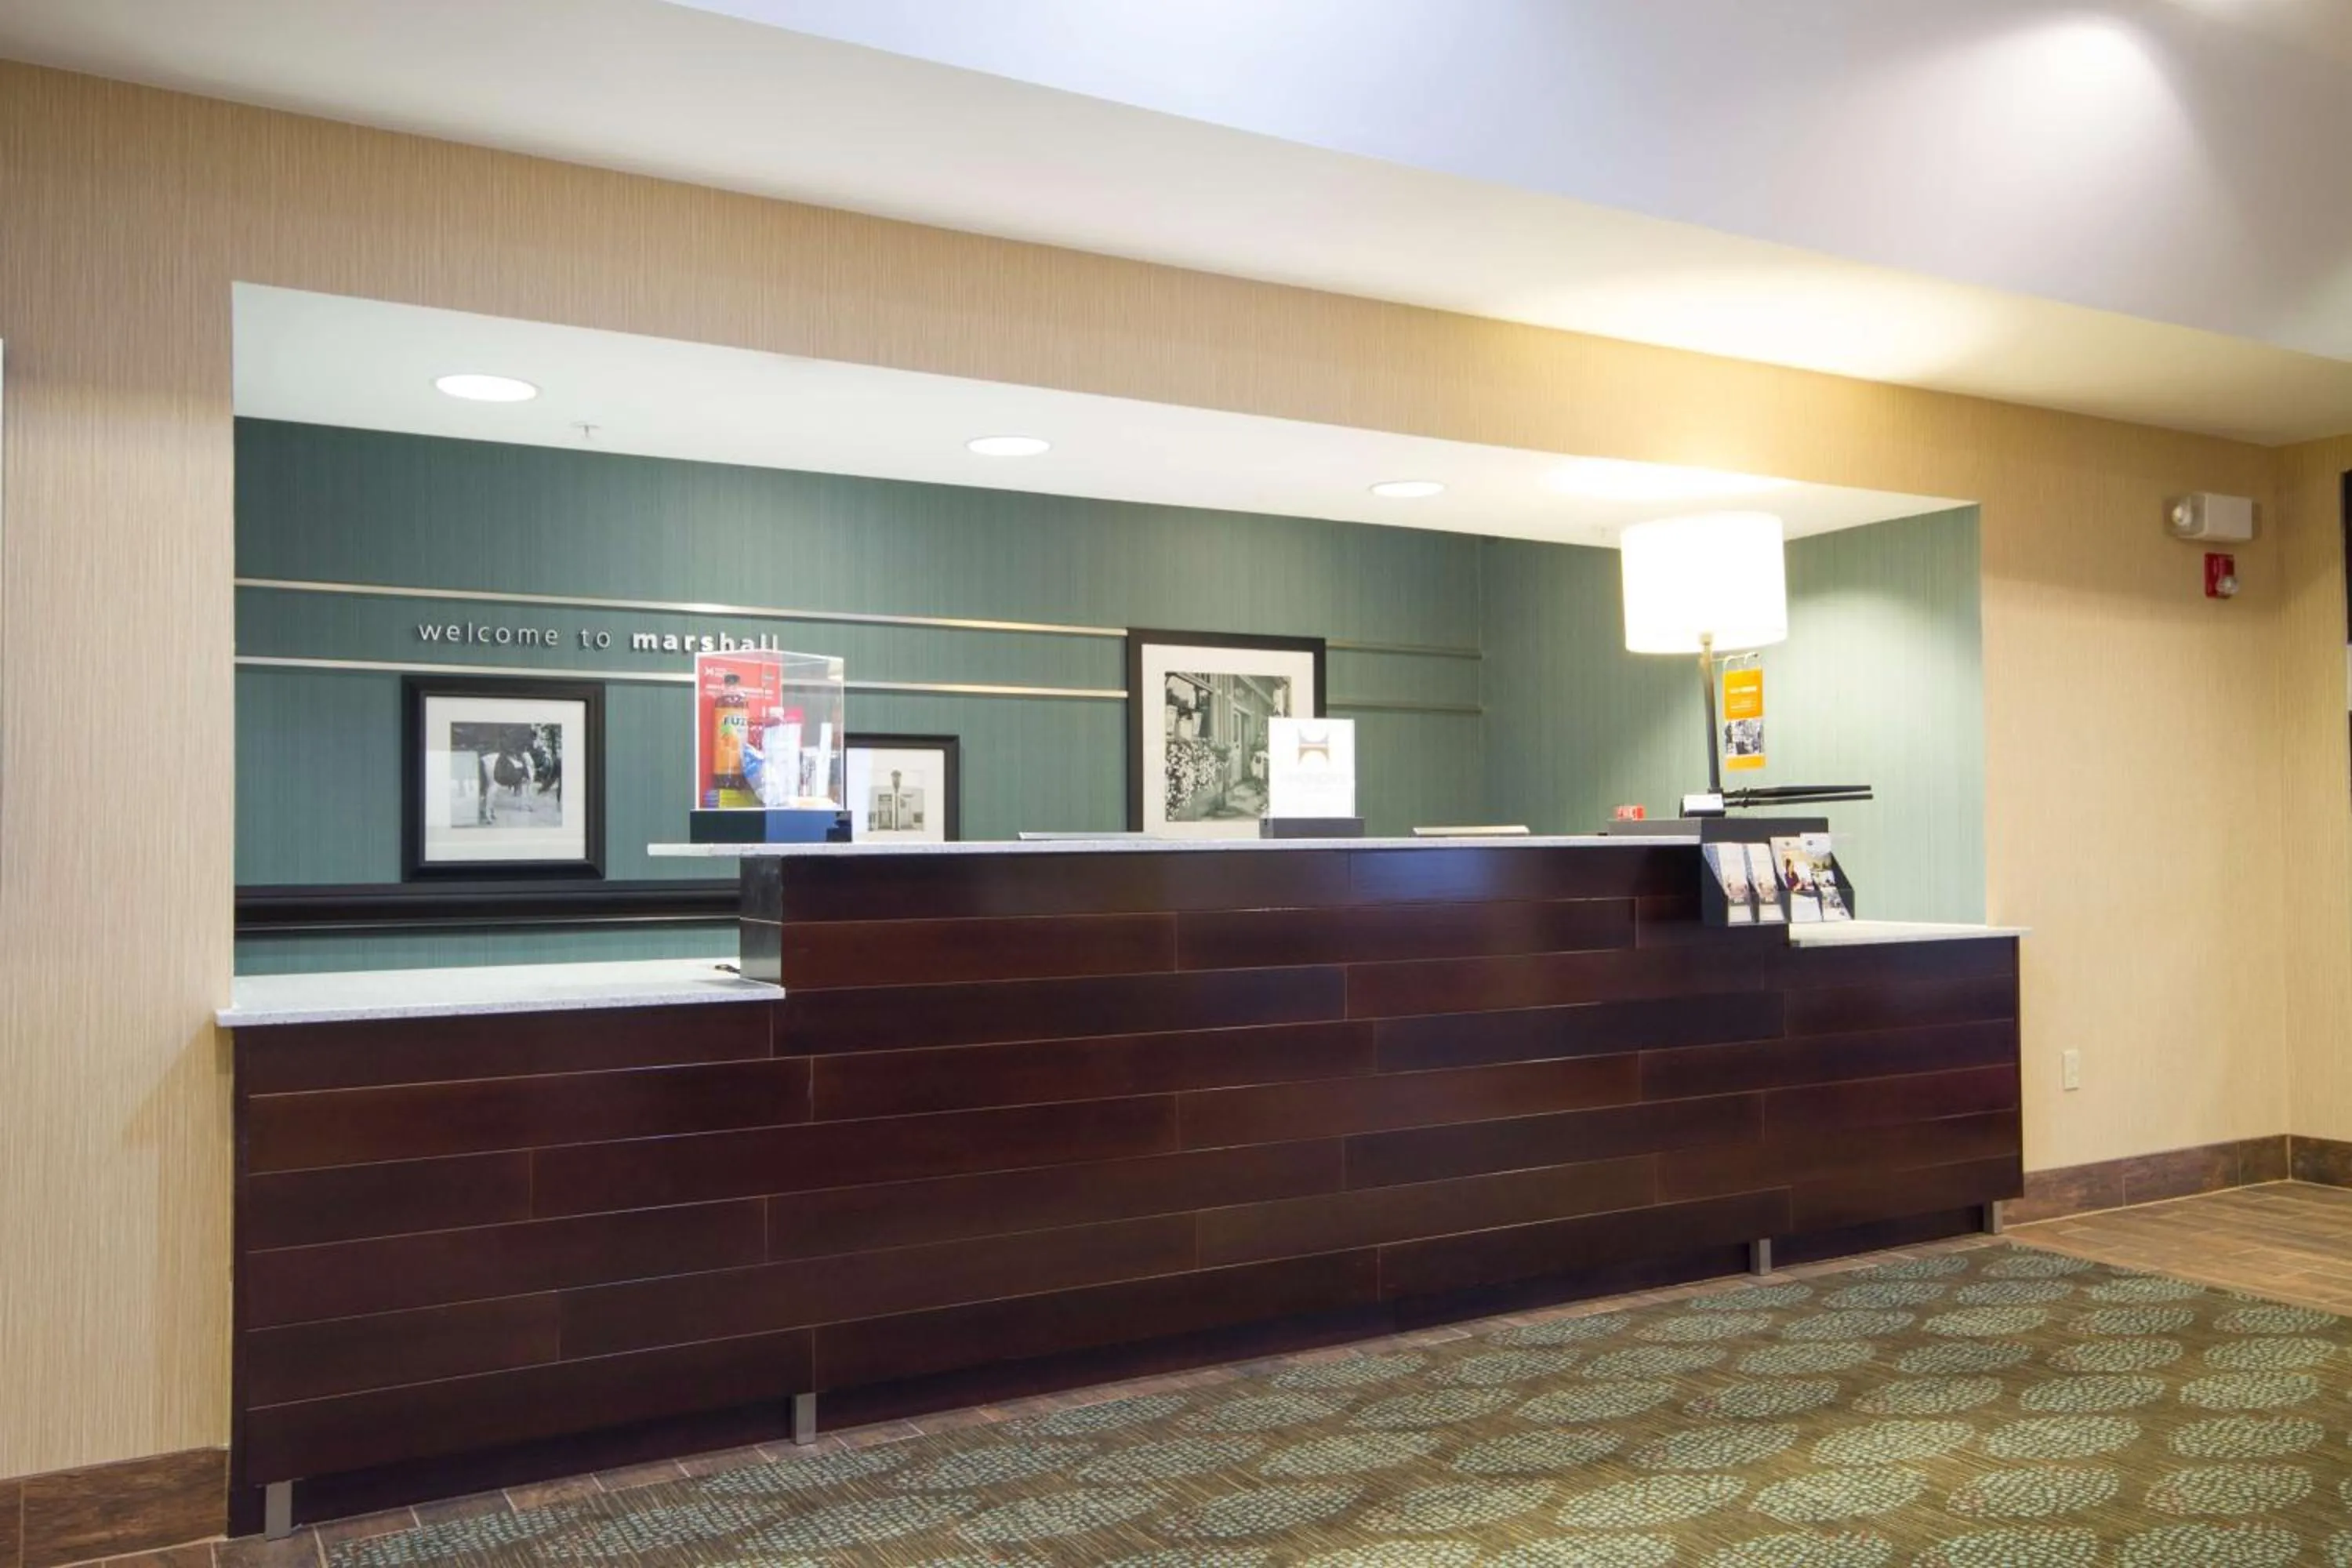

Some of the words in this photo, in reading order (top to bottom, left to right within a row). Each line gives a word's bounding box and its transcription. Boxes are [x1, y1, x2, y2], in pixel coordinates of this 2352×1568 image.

[418, 622, 559, 645] welcome
[580, 628, 612, 648] to
[632, 631, 779, 652] marshall
